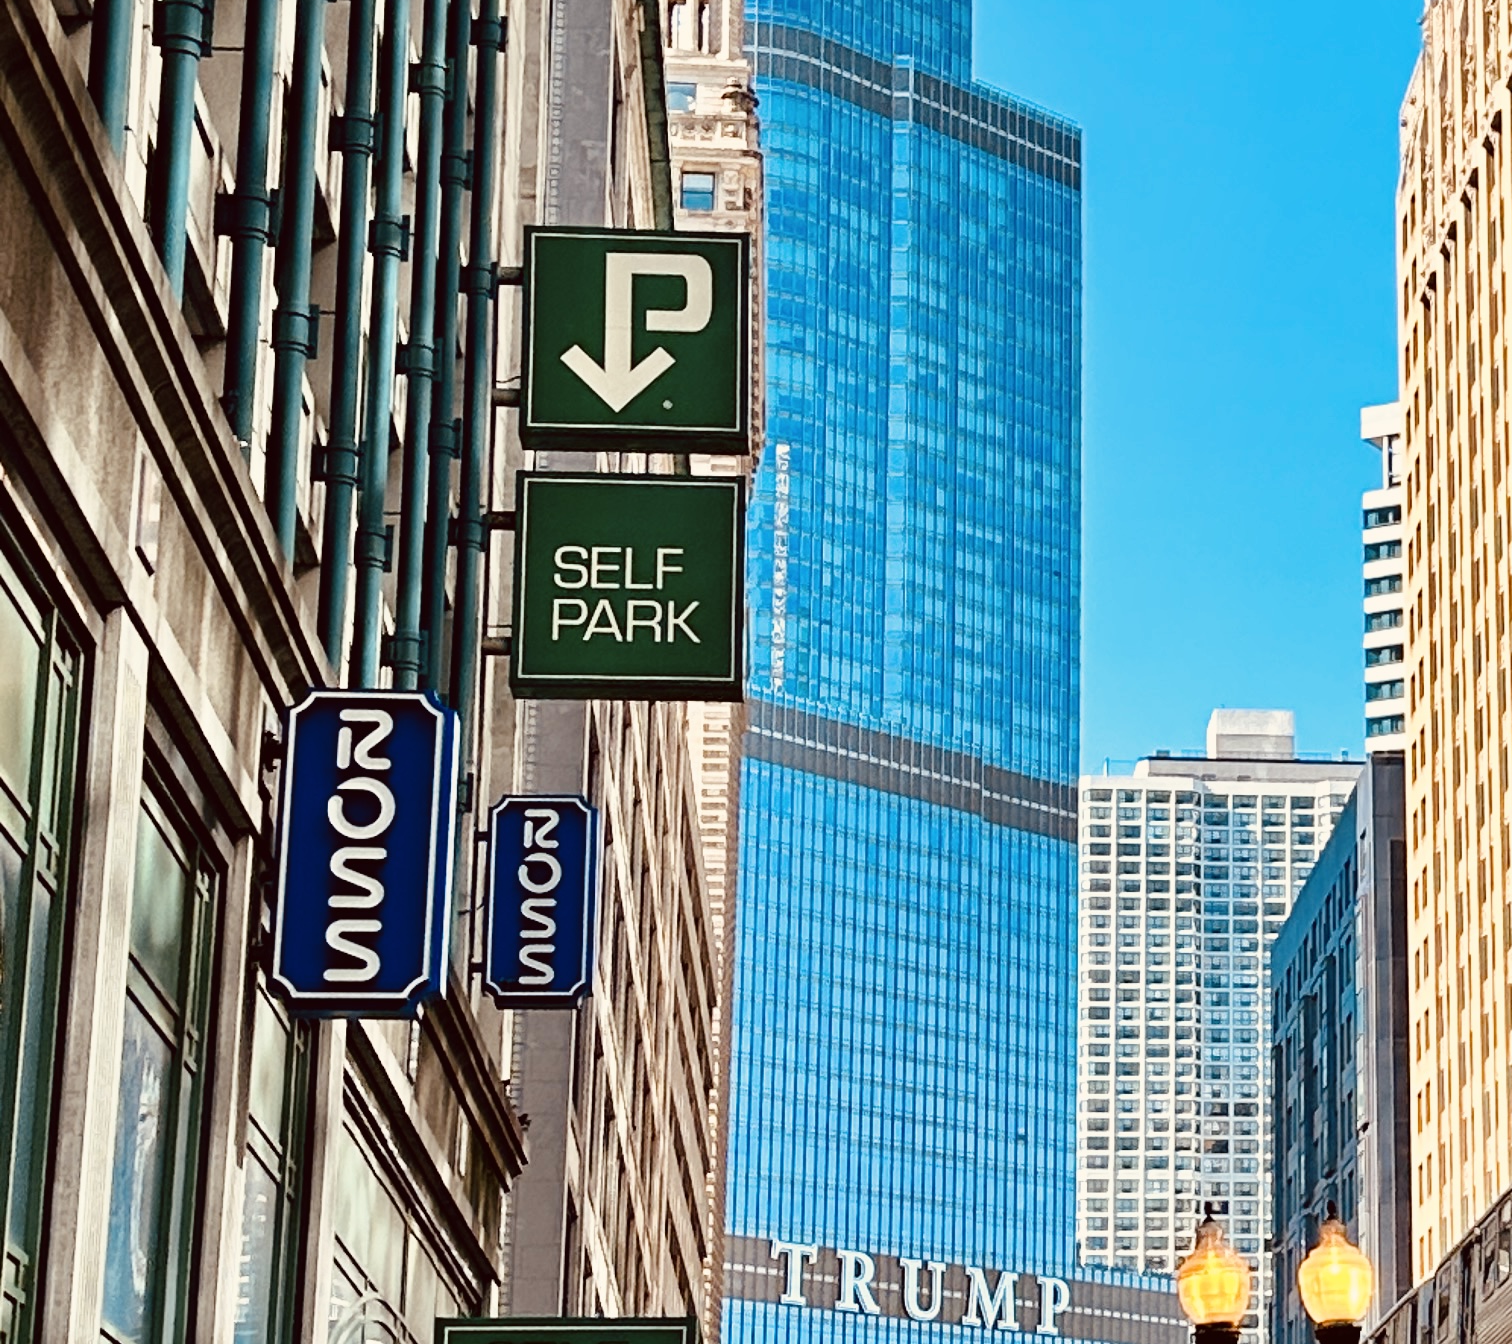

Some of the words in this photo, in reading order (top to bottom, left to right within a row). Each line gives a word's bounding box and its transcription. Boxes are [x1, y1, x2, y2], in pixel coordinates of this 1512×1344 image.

[553, 544, 685, 591] SELF
[551, 597, 702, 645] PARK
[322, 708, 397, 983] ROSS
[517, 808, 563, 986] ROSS
[770, 1238, 1071, 1336] TRUMP
